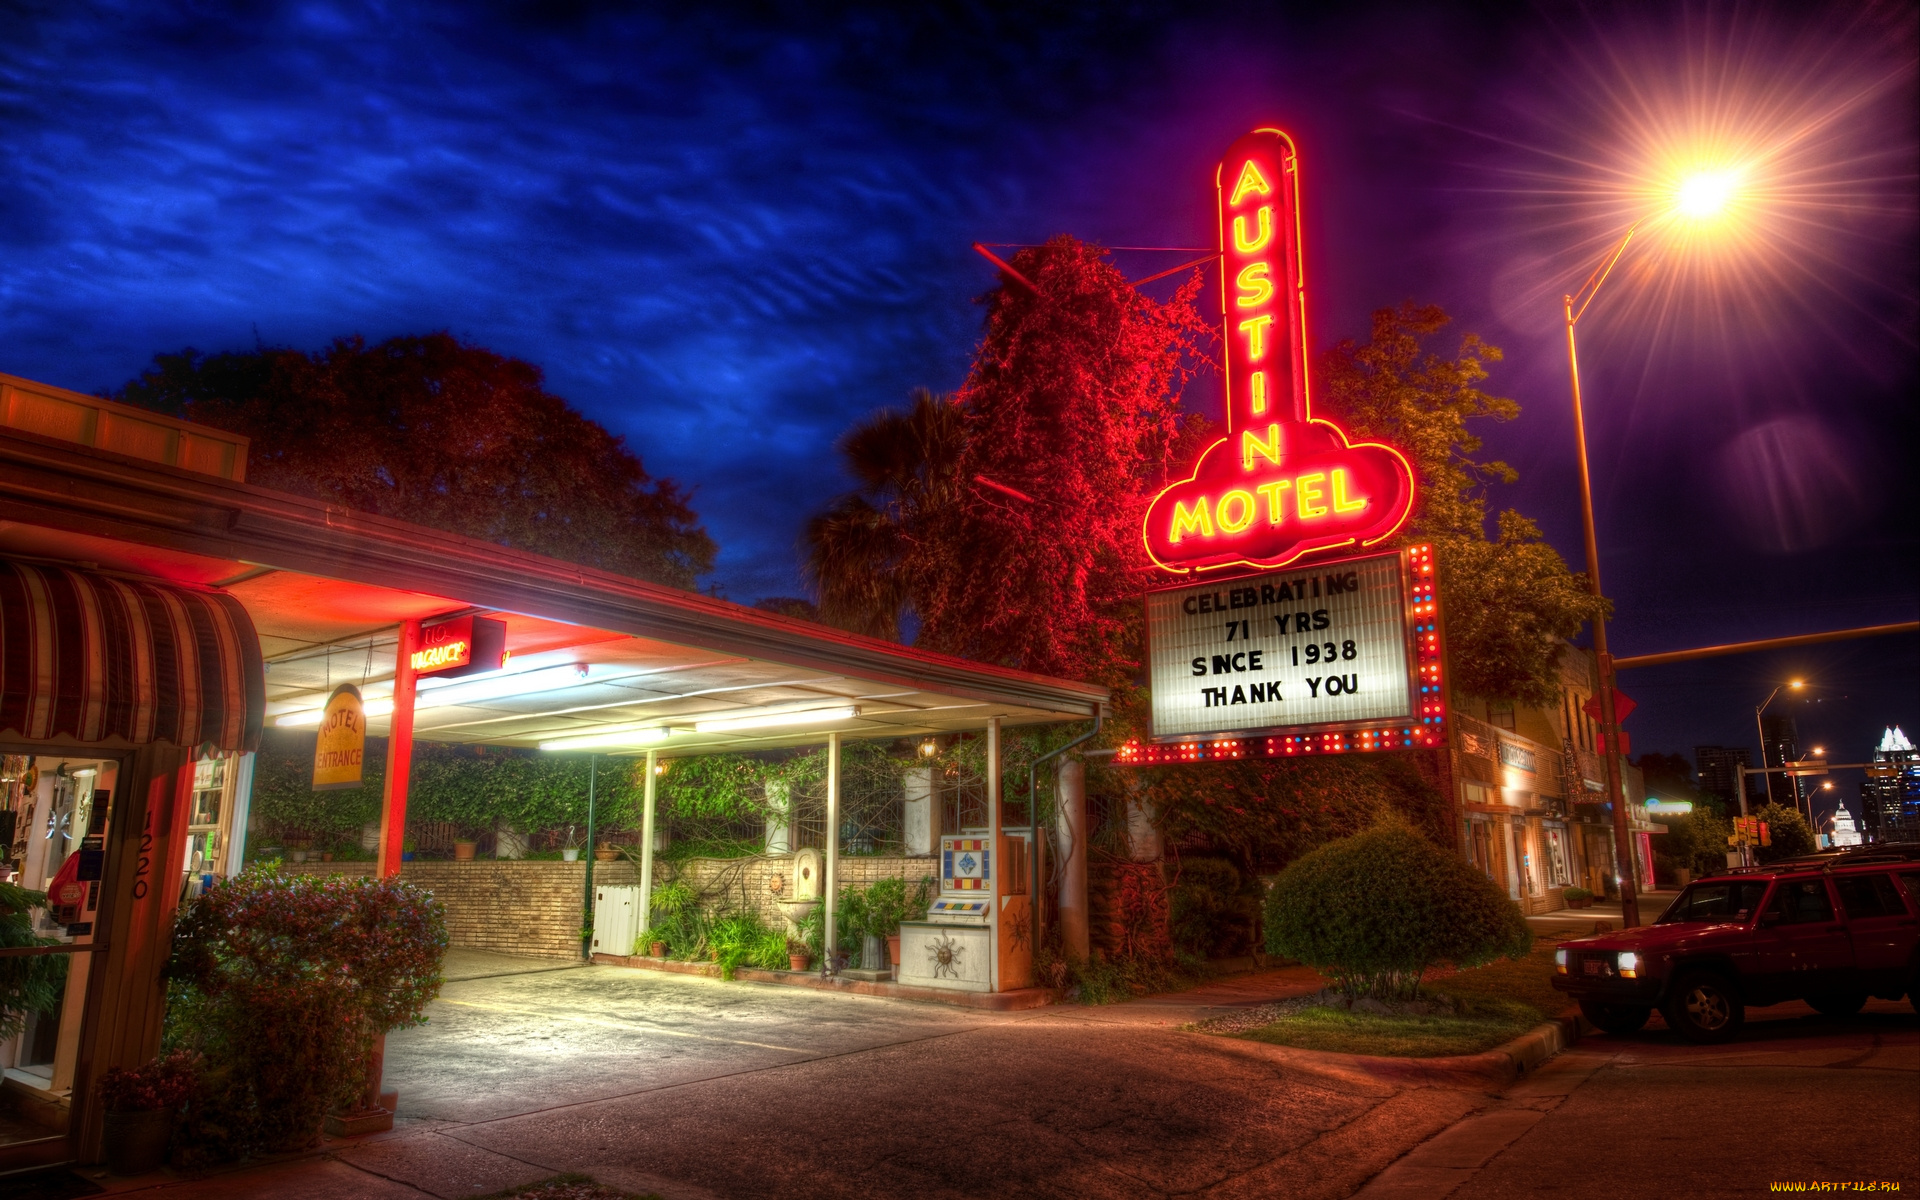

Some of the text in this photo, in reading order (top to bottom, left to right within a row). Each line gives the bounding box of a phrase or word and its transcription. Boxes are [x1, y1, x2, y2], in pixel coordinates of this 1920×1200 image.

[1230, 160, 1281, 471] AUSTIN
[1168, 468, 1368, 543] MOTEL
[1183, 572, 1358, 614] CELEBRATING
[1226, 609, 1330, 642] 71 YRS
[1292, 640, 1358, 666] 1938
[1201, 673, 1358, 708] THANK YOU
[323, 708, 358, 738] MOTEL
[317, 748, 362, 769] ENTRANCE
[133, 810, 153, 900] 1220
